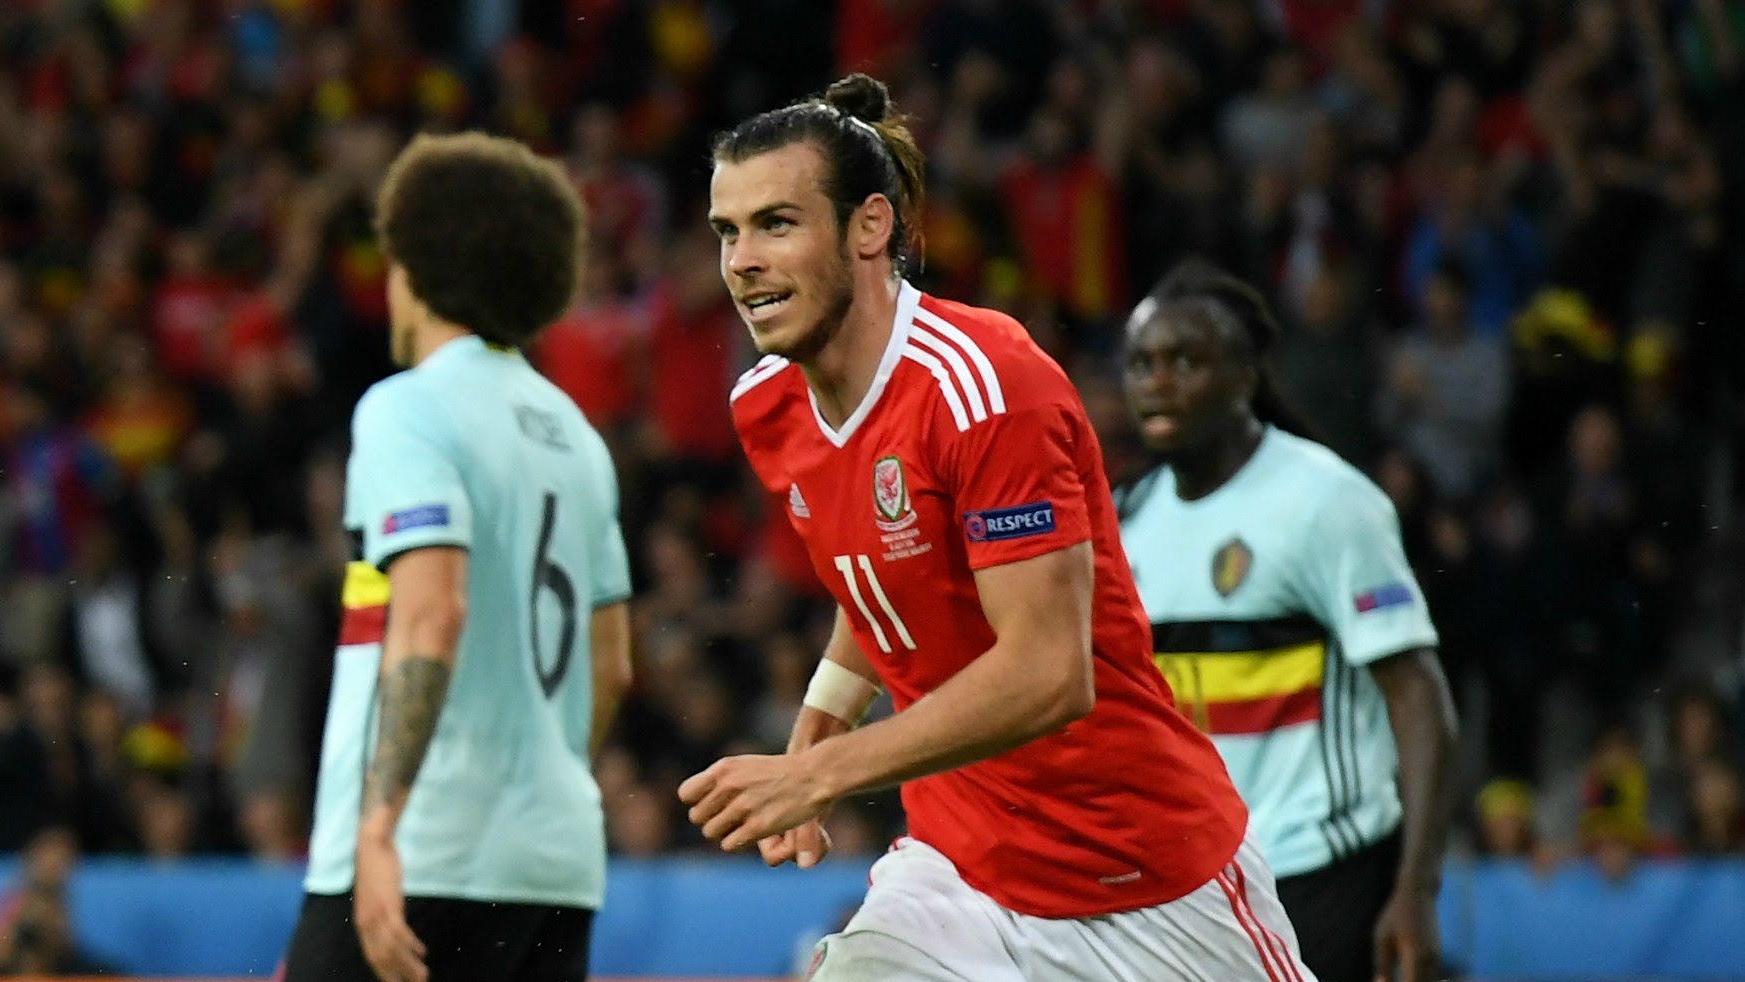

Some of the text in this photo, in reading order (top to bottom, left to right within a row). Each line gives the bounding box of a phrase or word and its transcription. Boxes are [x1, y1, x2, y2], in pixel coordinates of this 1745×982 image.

[986, 509, 1052, 532] RESPECT
[530, 489, 576, 700] 6
[834, 554, 917, 654] 11
